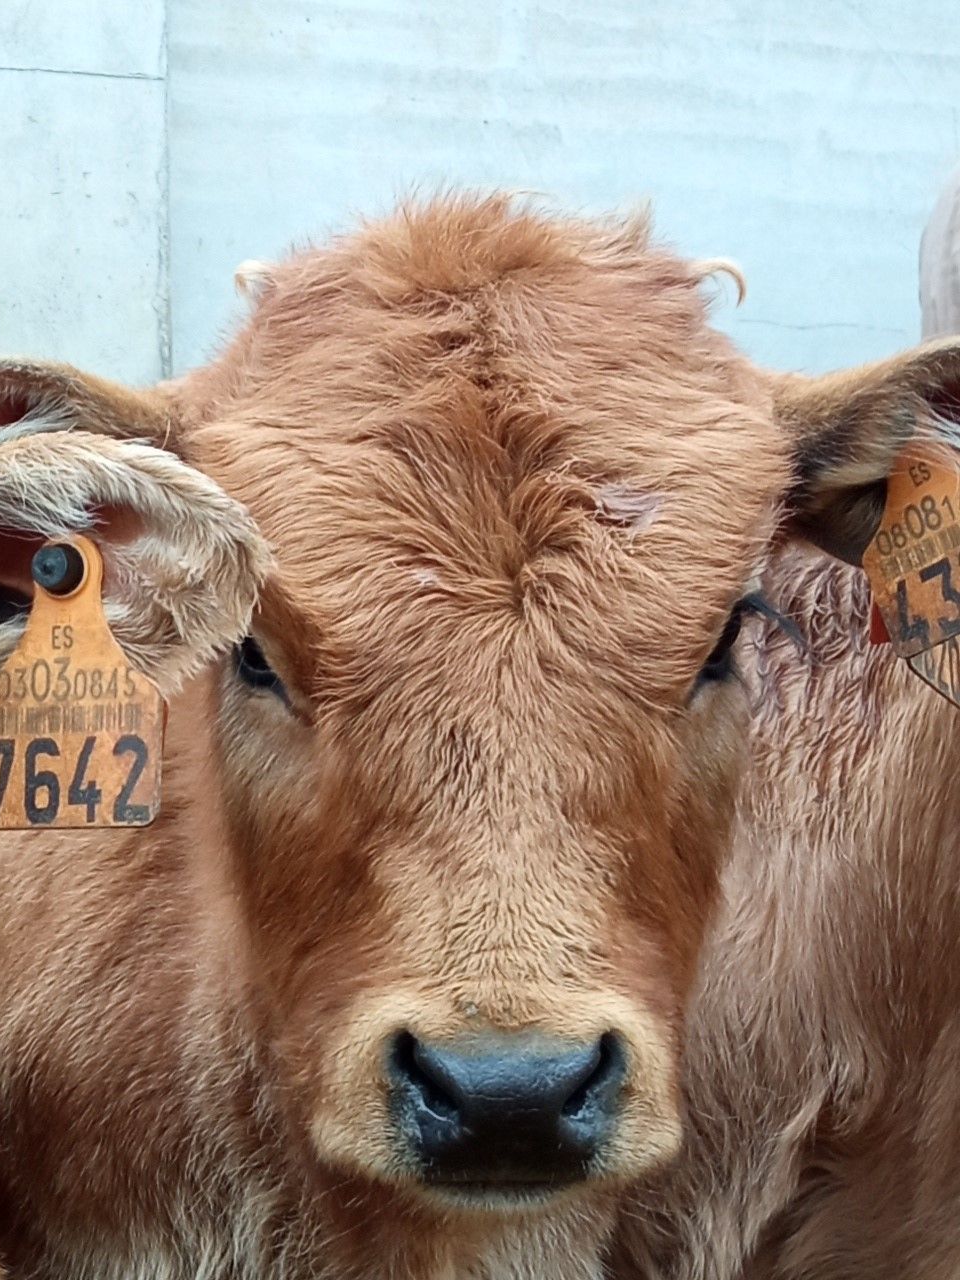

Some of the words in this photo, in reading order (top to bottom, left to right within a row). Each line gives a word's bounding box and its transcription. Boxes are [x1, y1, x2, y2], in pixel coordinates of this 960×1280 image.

[908, 461, 932, 488] ES
[876, 494, 960, 557] 08081
[896, 555, 960, 650] 43
[51, 624, 74, 650] ES
